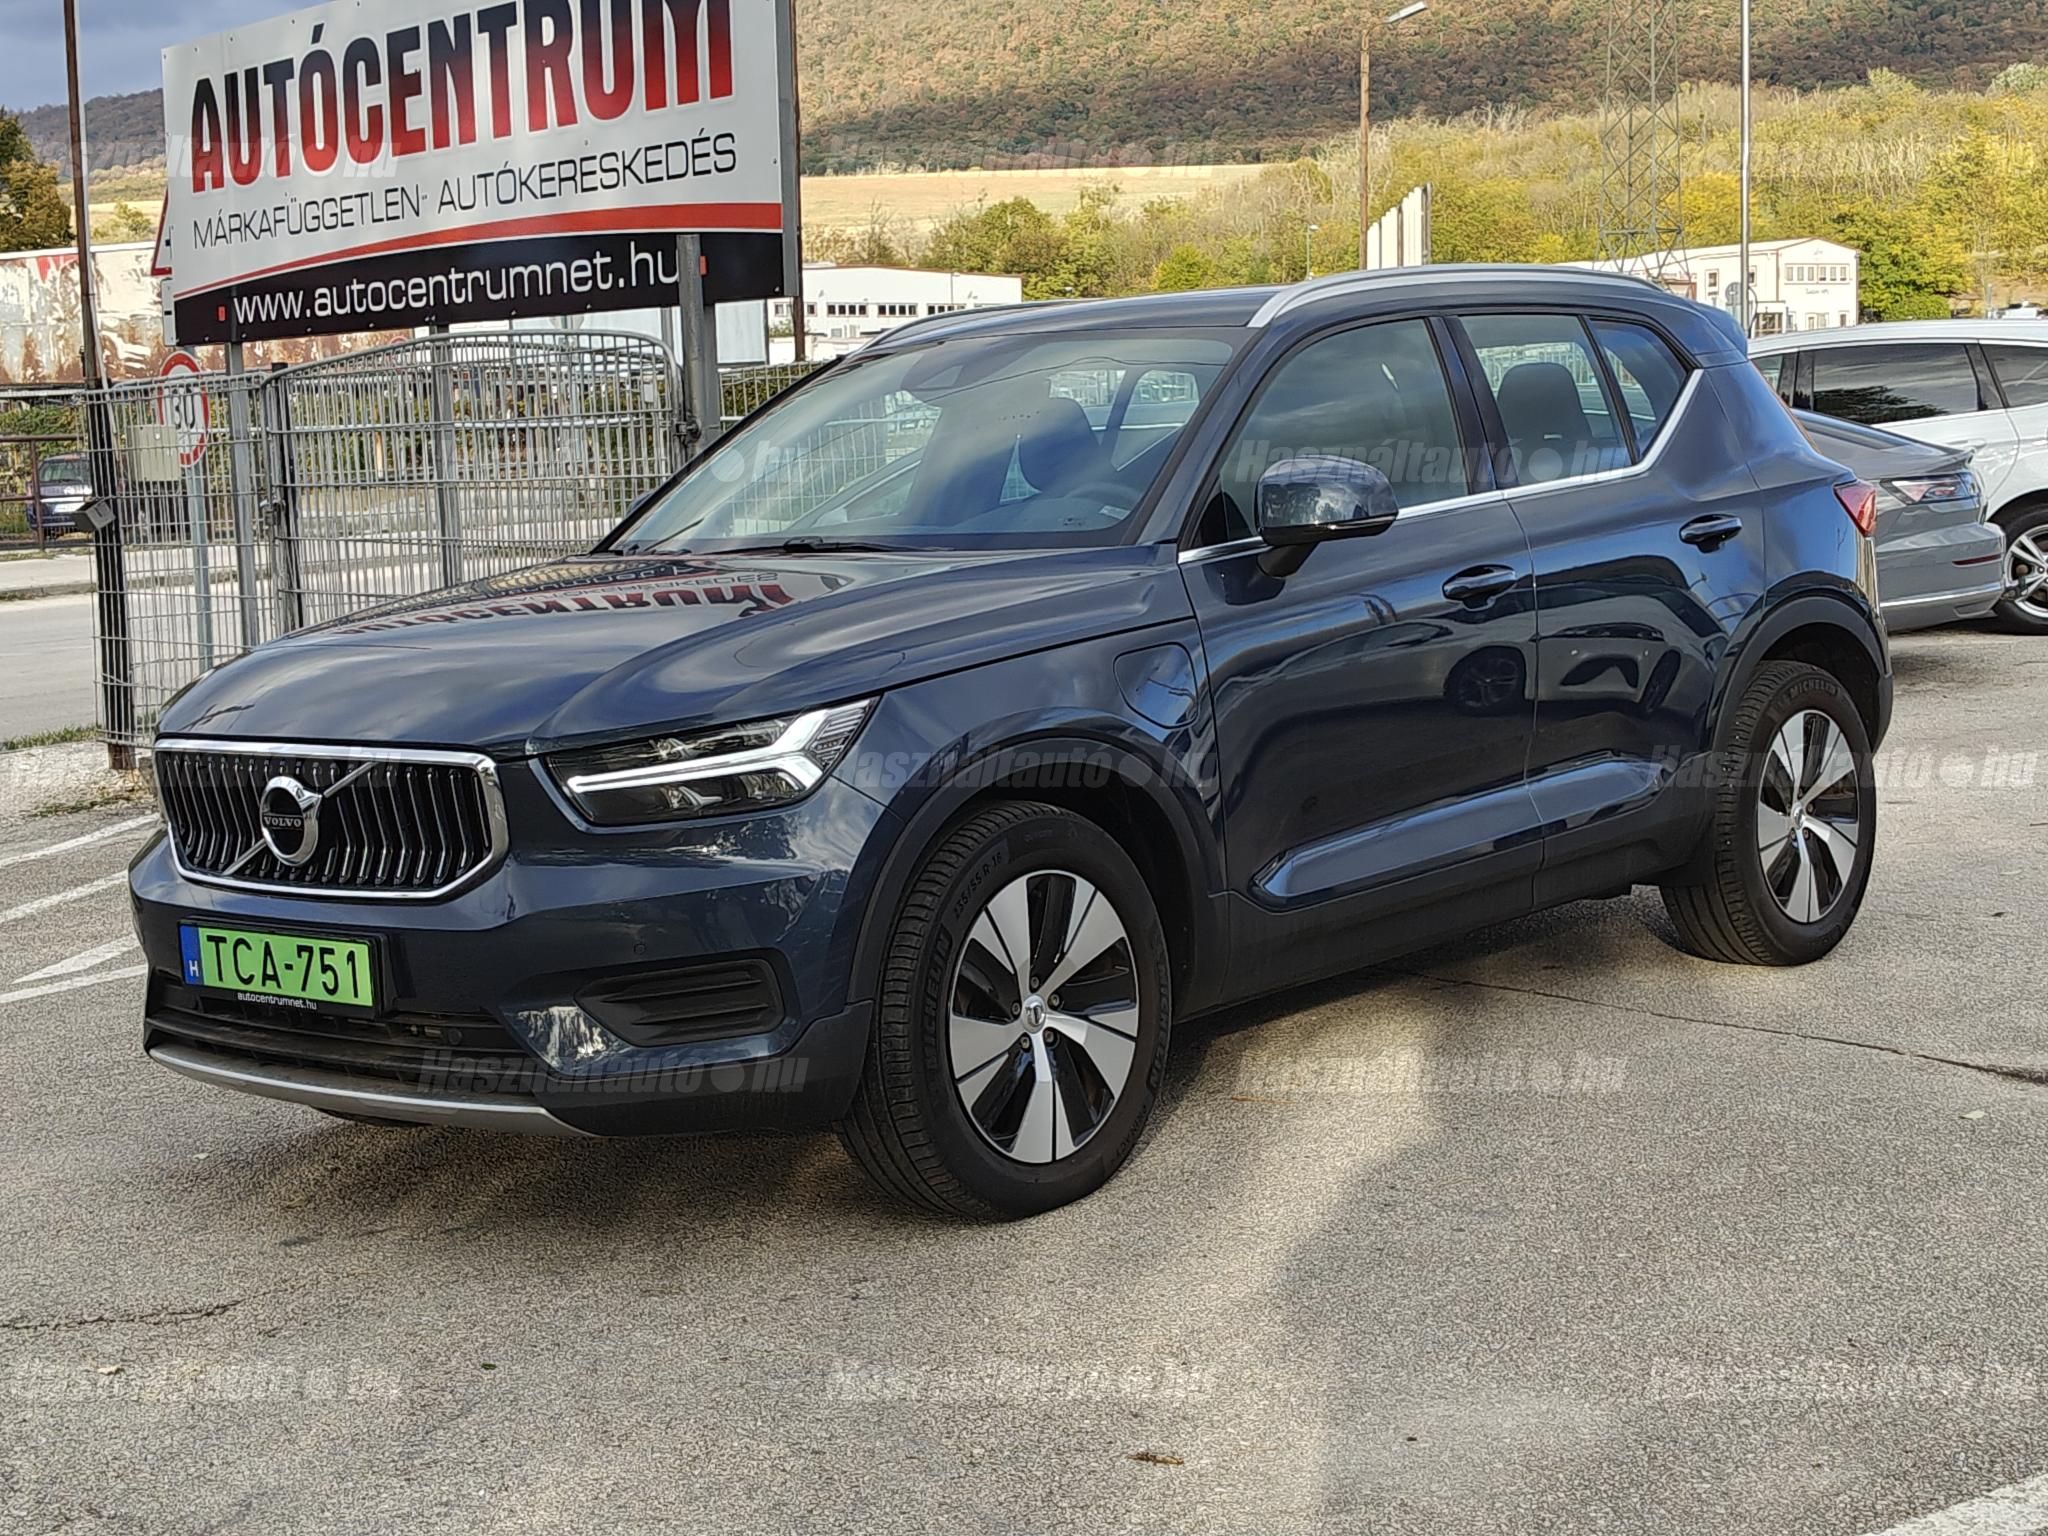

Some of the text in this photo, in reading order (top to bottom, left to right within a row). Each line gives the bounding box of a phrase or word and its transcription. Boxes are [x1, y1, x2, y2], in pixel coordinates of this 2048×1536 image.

[191, 0, 733, 193] AUTÓCENTRUM
[193, 127, 737, 249] MÁRKAFÜGGETLEN AUTÓKERESKEDÉS
[233, 240, 679, 325] www.autocentrumnet.hu
[263, 816, 302, 828] VOLVO
[188, 934, 360, 999] H TCA-751
[237, 992, 317, 1010] autocentrumnet.hu
